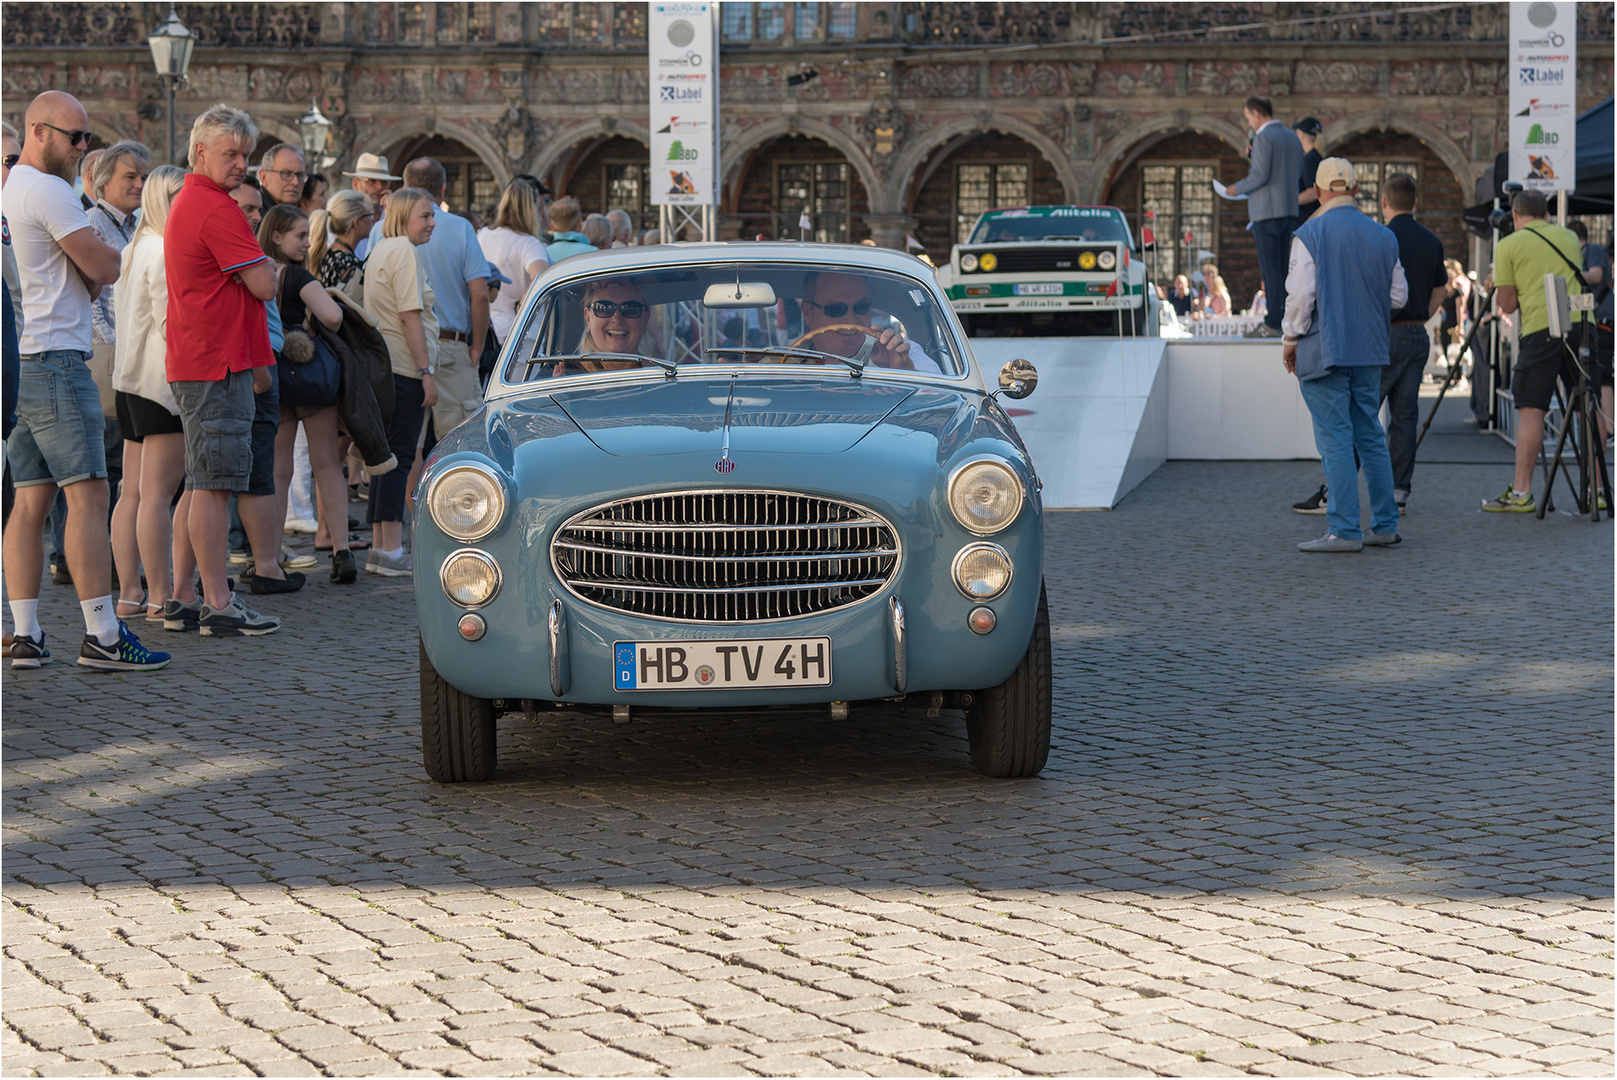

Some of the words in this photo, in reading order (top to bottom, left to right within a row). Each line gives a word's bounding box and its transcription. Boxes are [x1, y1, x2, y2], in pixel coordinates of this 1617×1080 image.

[1536, 68, 1564, 81] Label
[676, 86, 702, 99] Label
[1050, 208, 1111, 217] Alitalia
[621, 670, 630, 682] D
[639, 647, 689, 683] HB
[715, 645, 763, 681] TV
[774, 643, 824, 680] 4H
